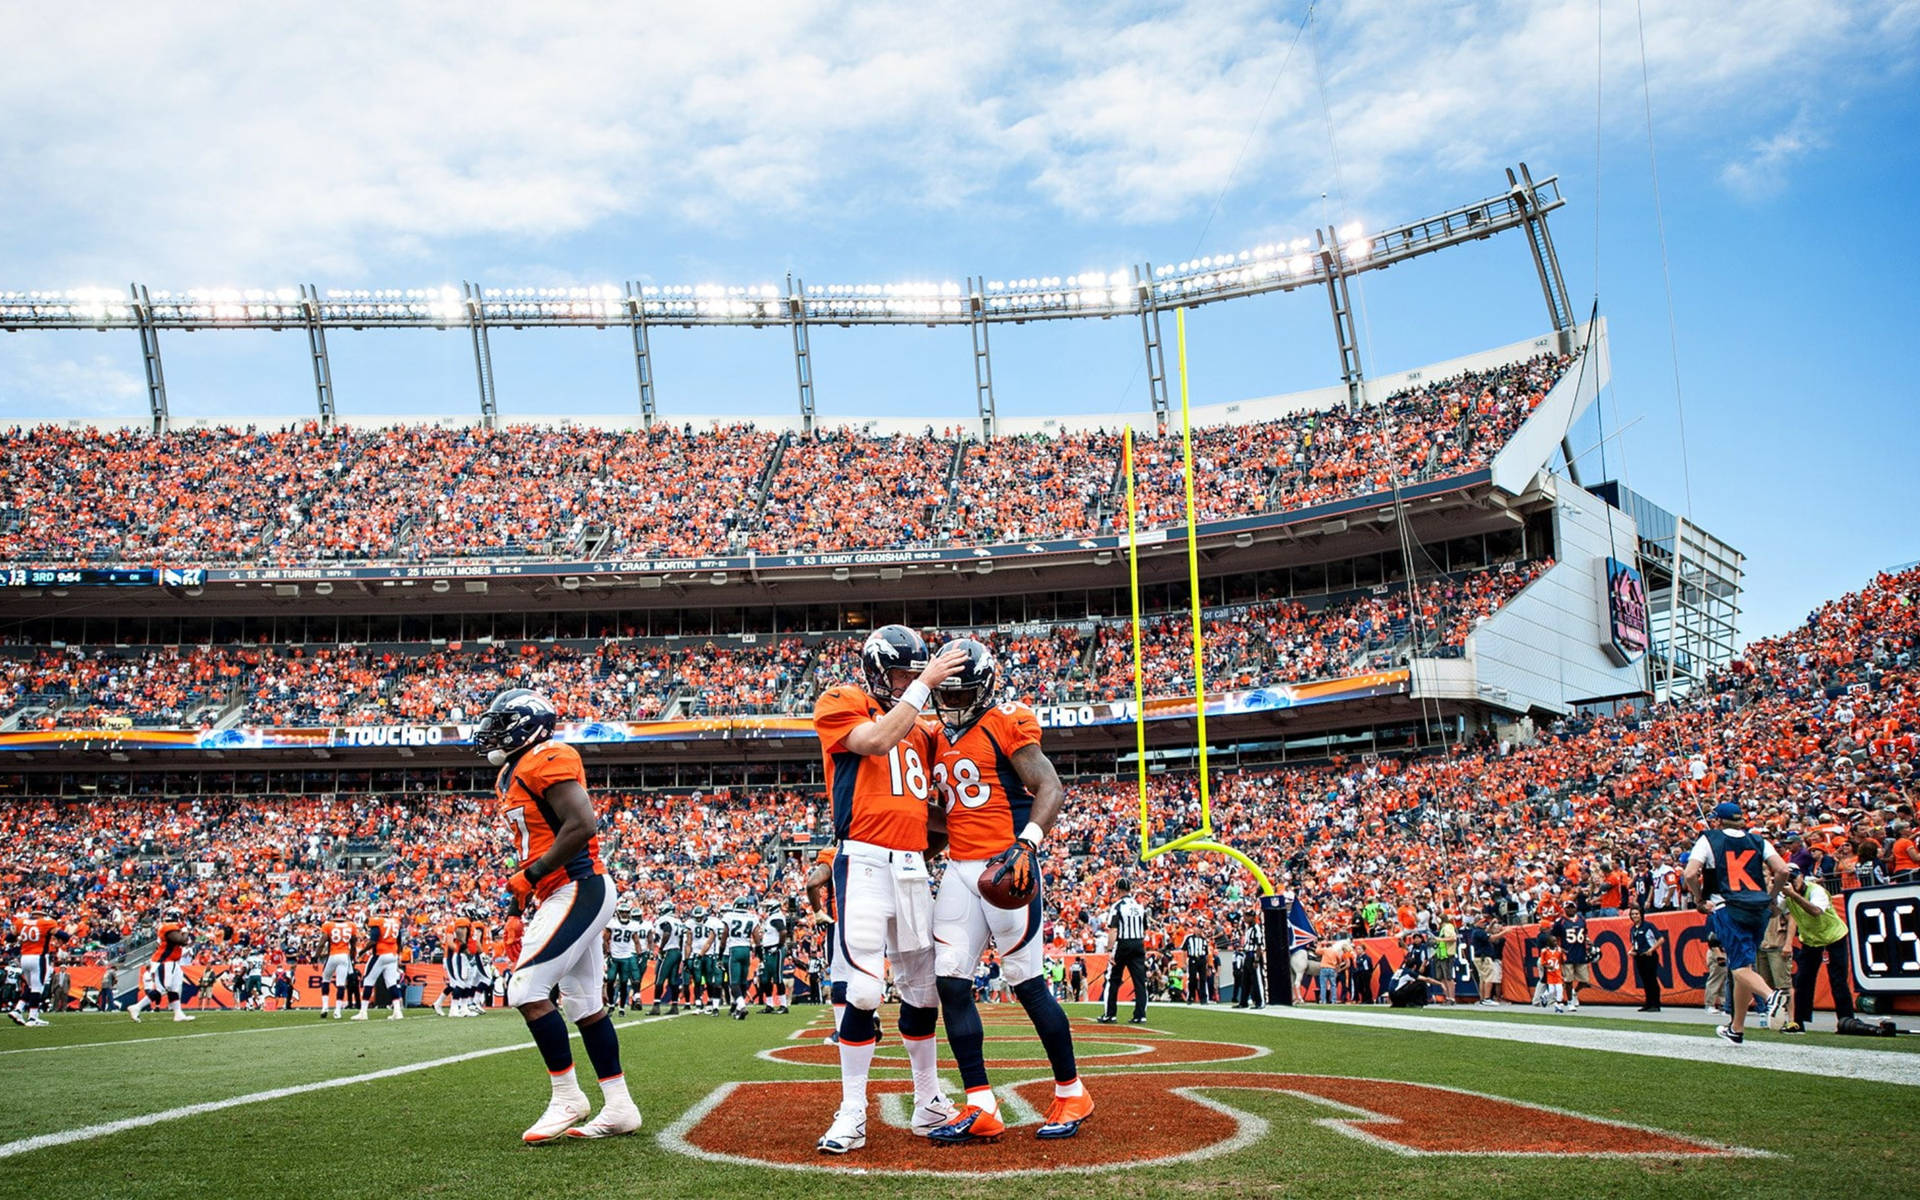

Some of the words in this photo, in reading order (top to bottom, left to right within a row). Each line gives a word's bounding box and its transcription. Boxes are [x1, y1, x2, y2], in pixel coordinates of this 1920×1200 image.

[803, 556, 815, 565] 53
[821, 555, 853, 564] RANDY
[855, 552, 912, 563] GRADISHAR
[407, 568, 419, 576] 25
[422, 567, 454, 576] HAVEN
[456, 566, 491, 575] MOSES
[610, 563, 617, 571] 7
[620, 562, 650, 571] CRAIG
[653, 561, 696, 570] MORTON
[32, 572, 54, 582] 3RD
[183, 569, 202, 580] 27
[246, 570, 257, 579] 15
[262, 570, 280, 579] JIM
[282, 569, 321, 579] TURNER
[1214, 608, 1228, 618] call
[888, 745, 928, 800] 18
[1725, 850, 1762, 891] K
[20, 925, 40, 942] 60
[331, 928, 352, 943] 85
[383, 922, 399, 939] 75
[613, 929, 632, 943] 29
[730, 920, 753, 938] 24
[1565, 928, 1585, 943] 56
[1864, 905, 1920, 971] 25
